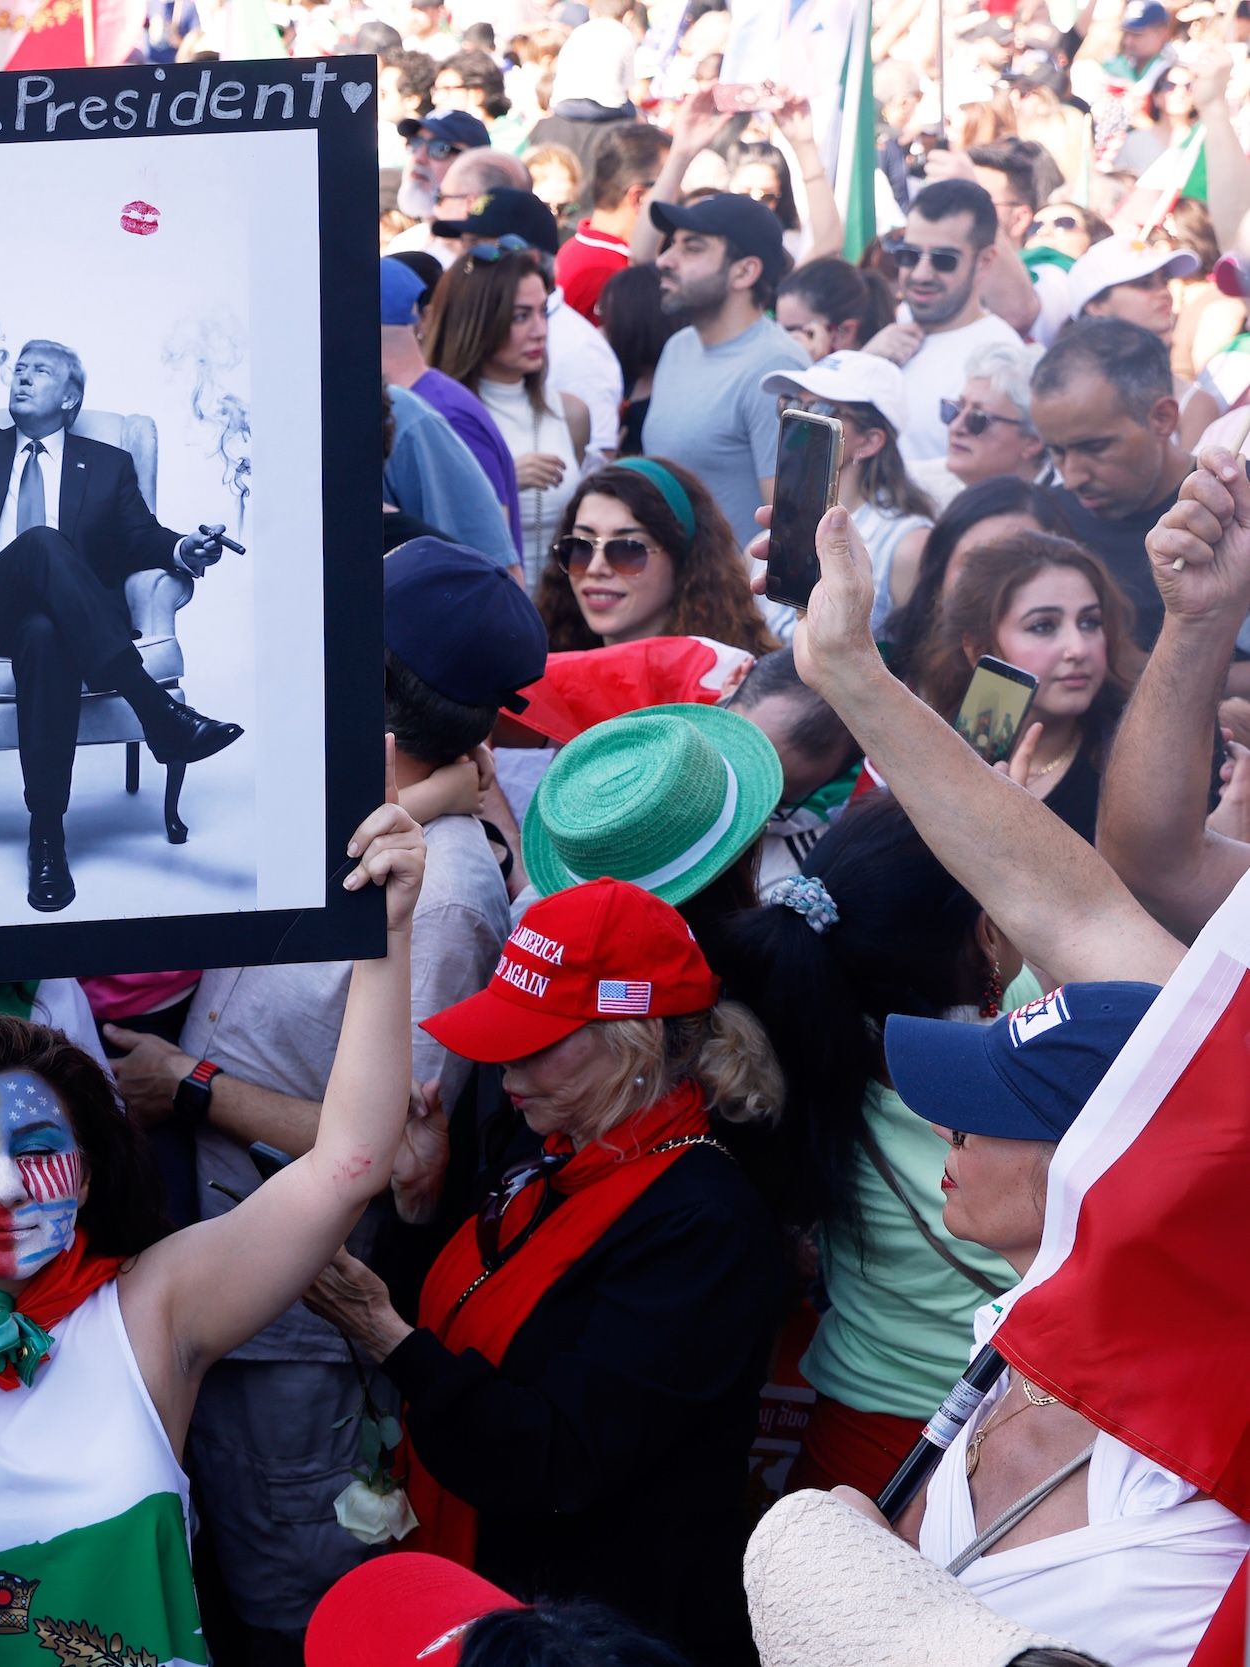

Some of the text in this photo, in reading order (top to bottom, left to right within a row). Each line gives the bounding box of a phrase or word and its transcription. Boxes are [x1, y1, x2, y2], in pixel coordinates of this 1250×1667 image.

[14, 61, 338, 132] President
[510, 925, 565, 967] AMERICA
[502, 961, 551, 998] AGAIN
[777, 1401, 809, 1429] ong
